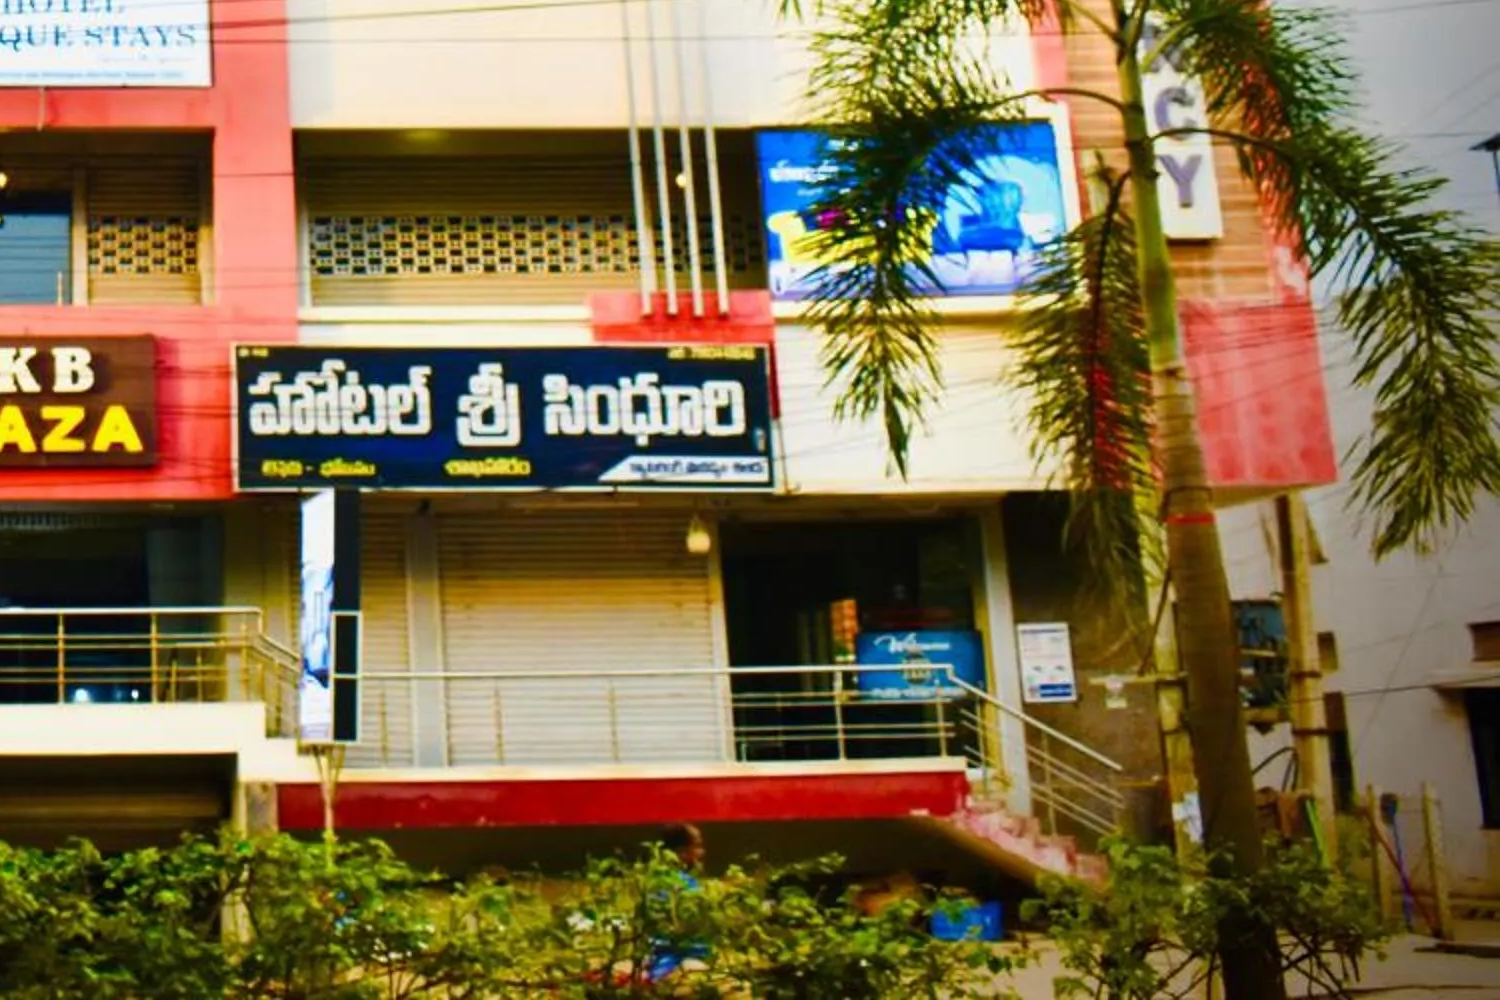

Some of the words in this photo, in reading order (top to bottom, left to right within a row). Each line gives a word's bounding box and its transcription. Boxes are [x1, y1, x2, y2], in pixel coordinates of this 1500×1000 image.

[84, 24, 197, 47] STAYS
[248, 359, 433, 436] హోటల్
[455, 362, 521, 447] శ్రీ
